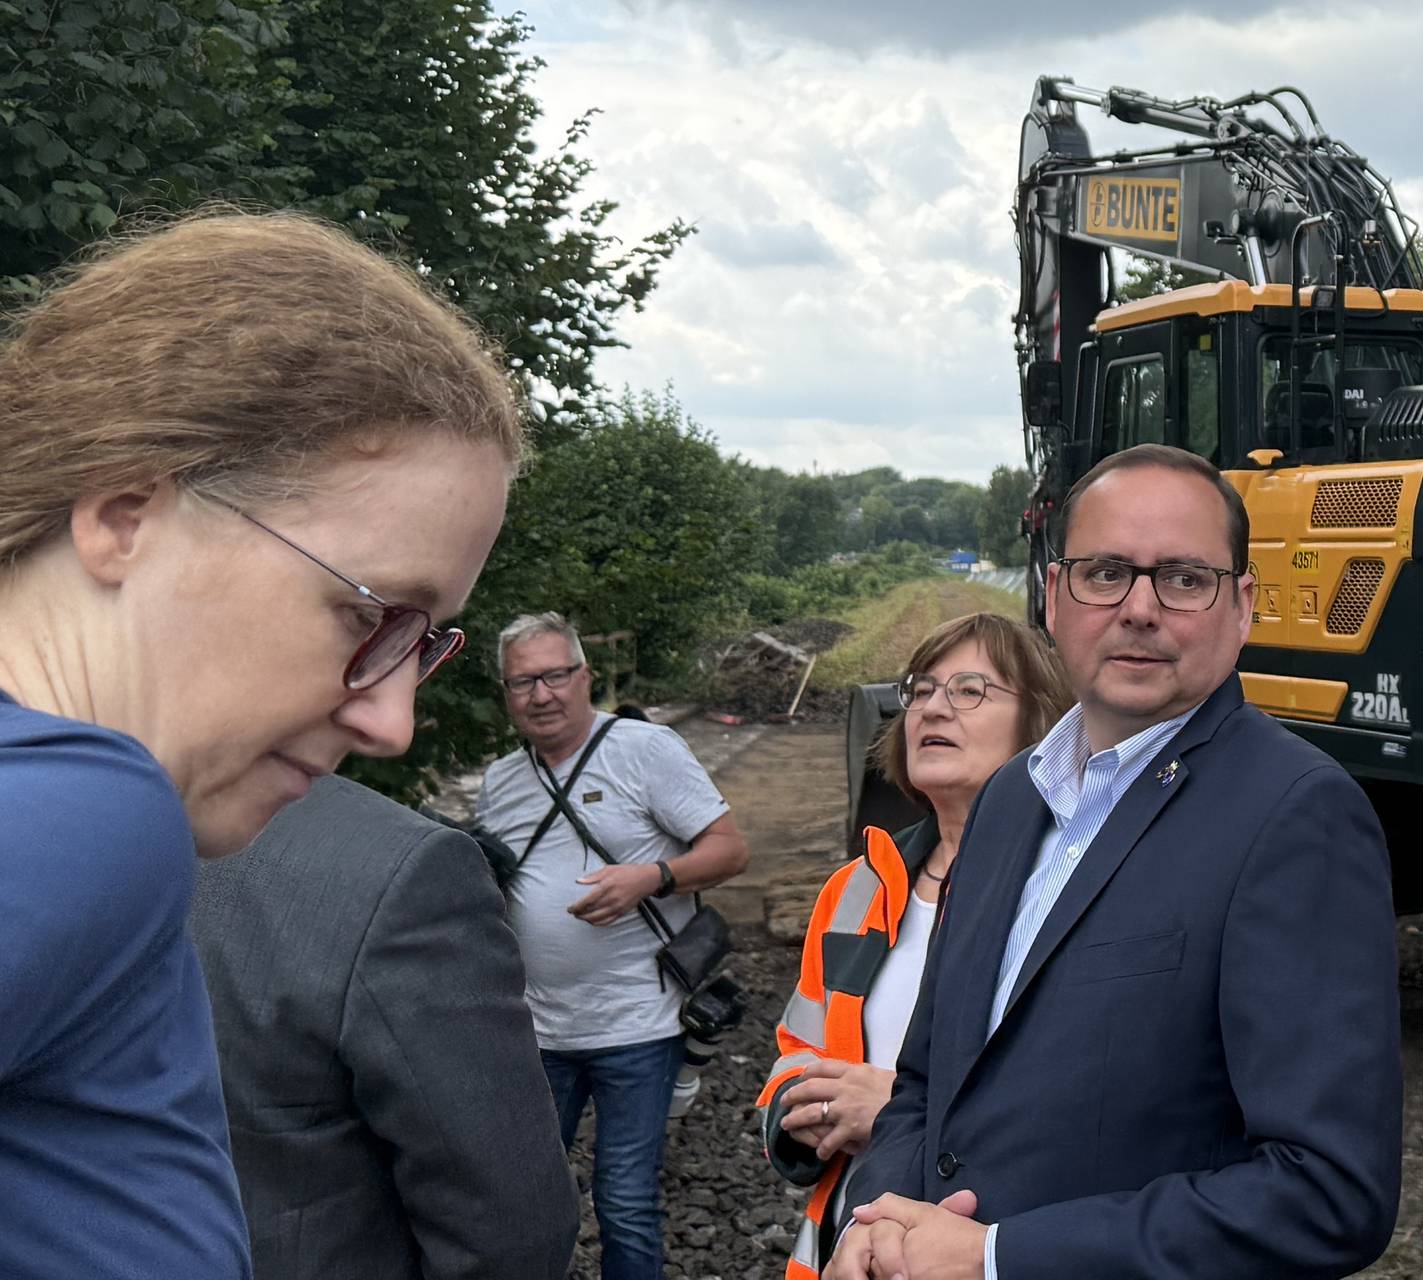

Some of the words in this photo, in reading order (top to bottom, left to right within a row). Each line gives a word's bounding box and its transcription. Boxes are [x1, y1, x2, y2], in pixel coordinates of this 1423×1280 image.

[1106, 184, 1177, 232] BUNTE
[1344, 389, 1364, 399] DAI
[1292, 551, 1319, 569] 43571
[1377, 673, 1399, 693] HX
